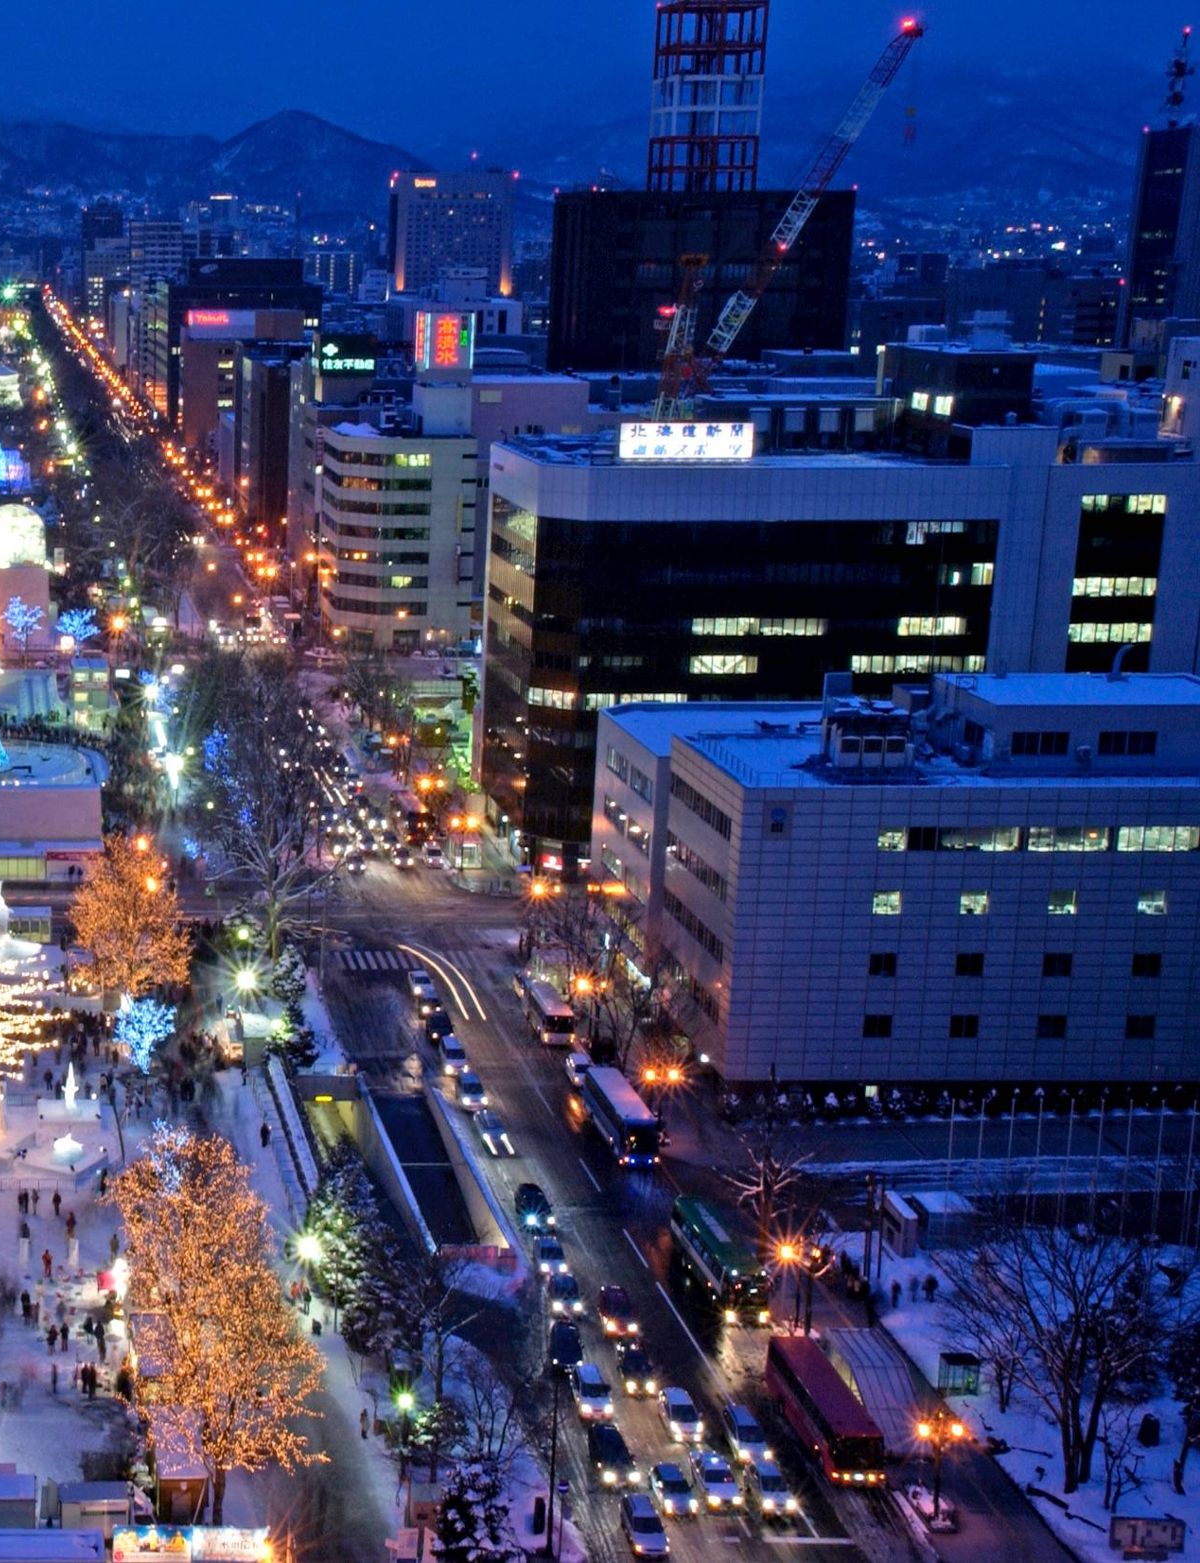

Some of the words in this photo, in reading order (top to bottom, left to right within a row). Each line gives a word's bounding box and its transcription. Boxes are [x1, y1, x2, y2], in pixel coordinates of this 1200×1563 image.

[322, 359, 375, 370] 住友不動産
[630, 424, 744, 437] 北海道新聞
[632, 444, 743, 455] 道新スポツ
